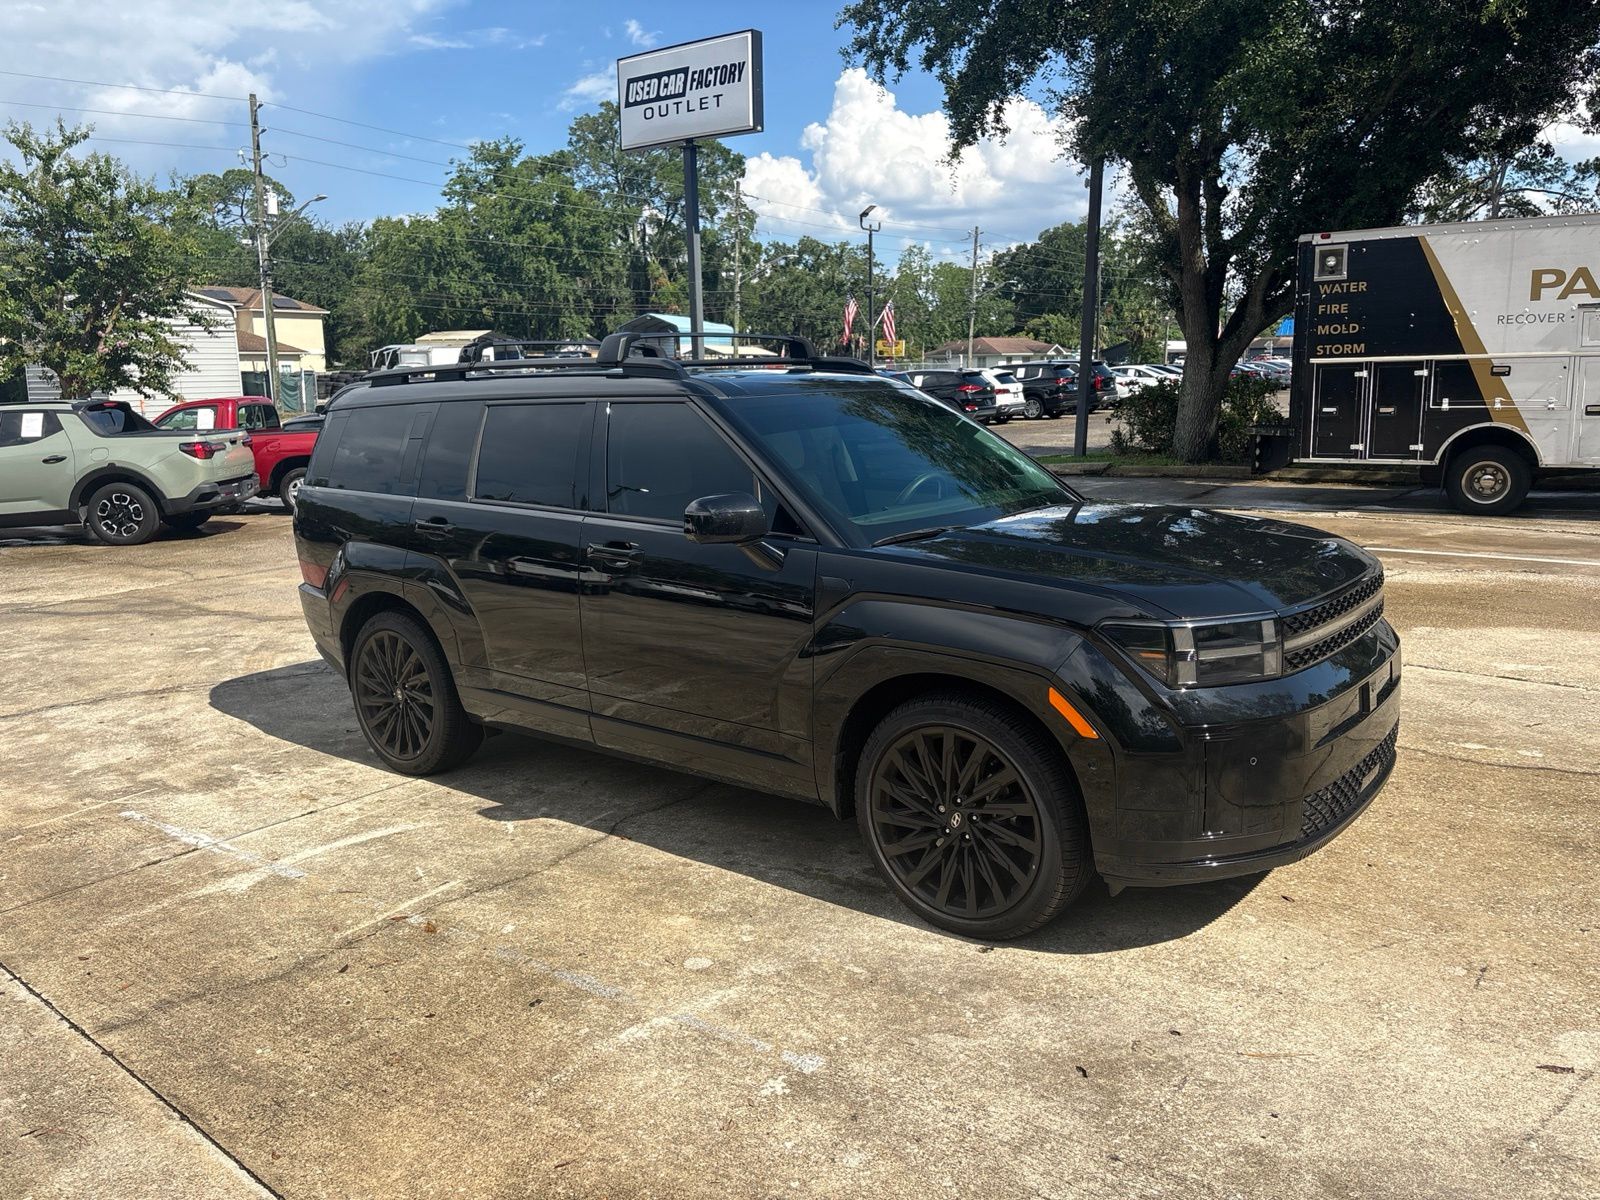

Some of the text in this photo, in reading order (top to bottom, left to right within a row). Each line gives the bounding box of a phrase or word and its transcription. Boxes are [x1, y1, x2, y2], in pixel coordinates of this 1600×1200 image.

[628, 61, 746, 103] USED CAR FACTORY
[643, 94, 723, 120] OUTLET
[1319, 281, 1367, 294] WATER
[1318, 303, 1349, 315] FIRE
[1497, 312, 1565, 325] RECOVER
[1317, 323, 1359, 335] MOLD
[1316, 343, 1365, 355] STORM
